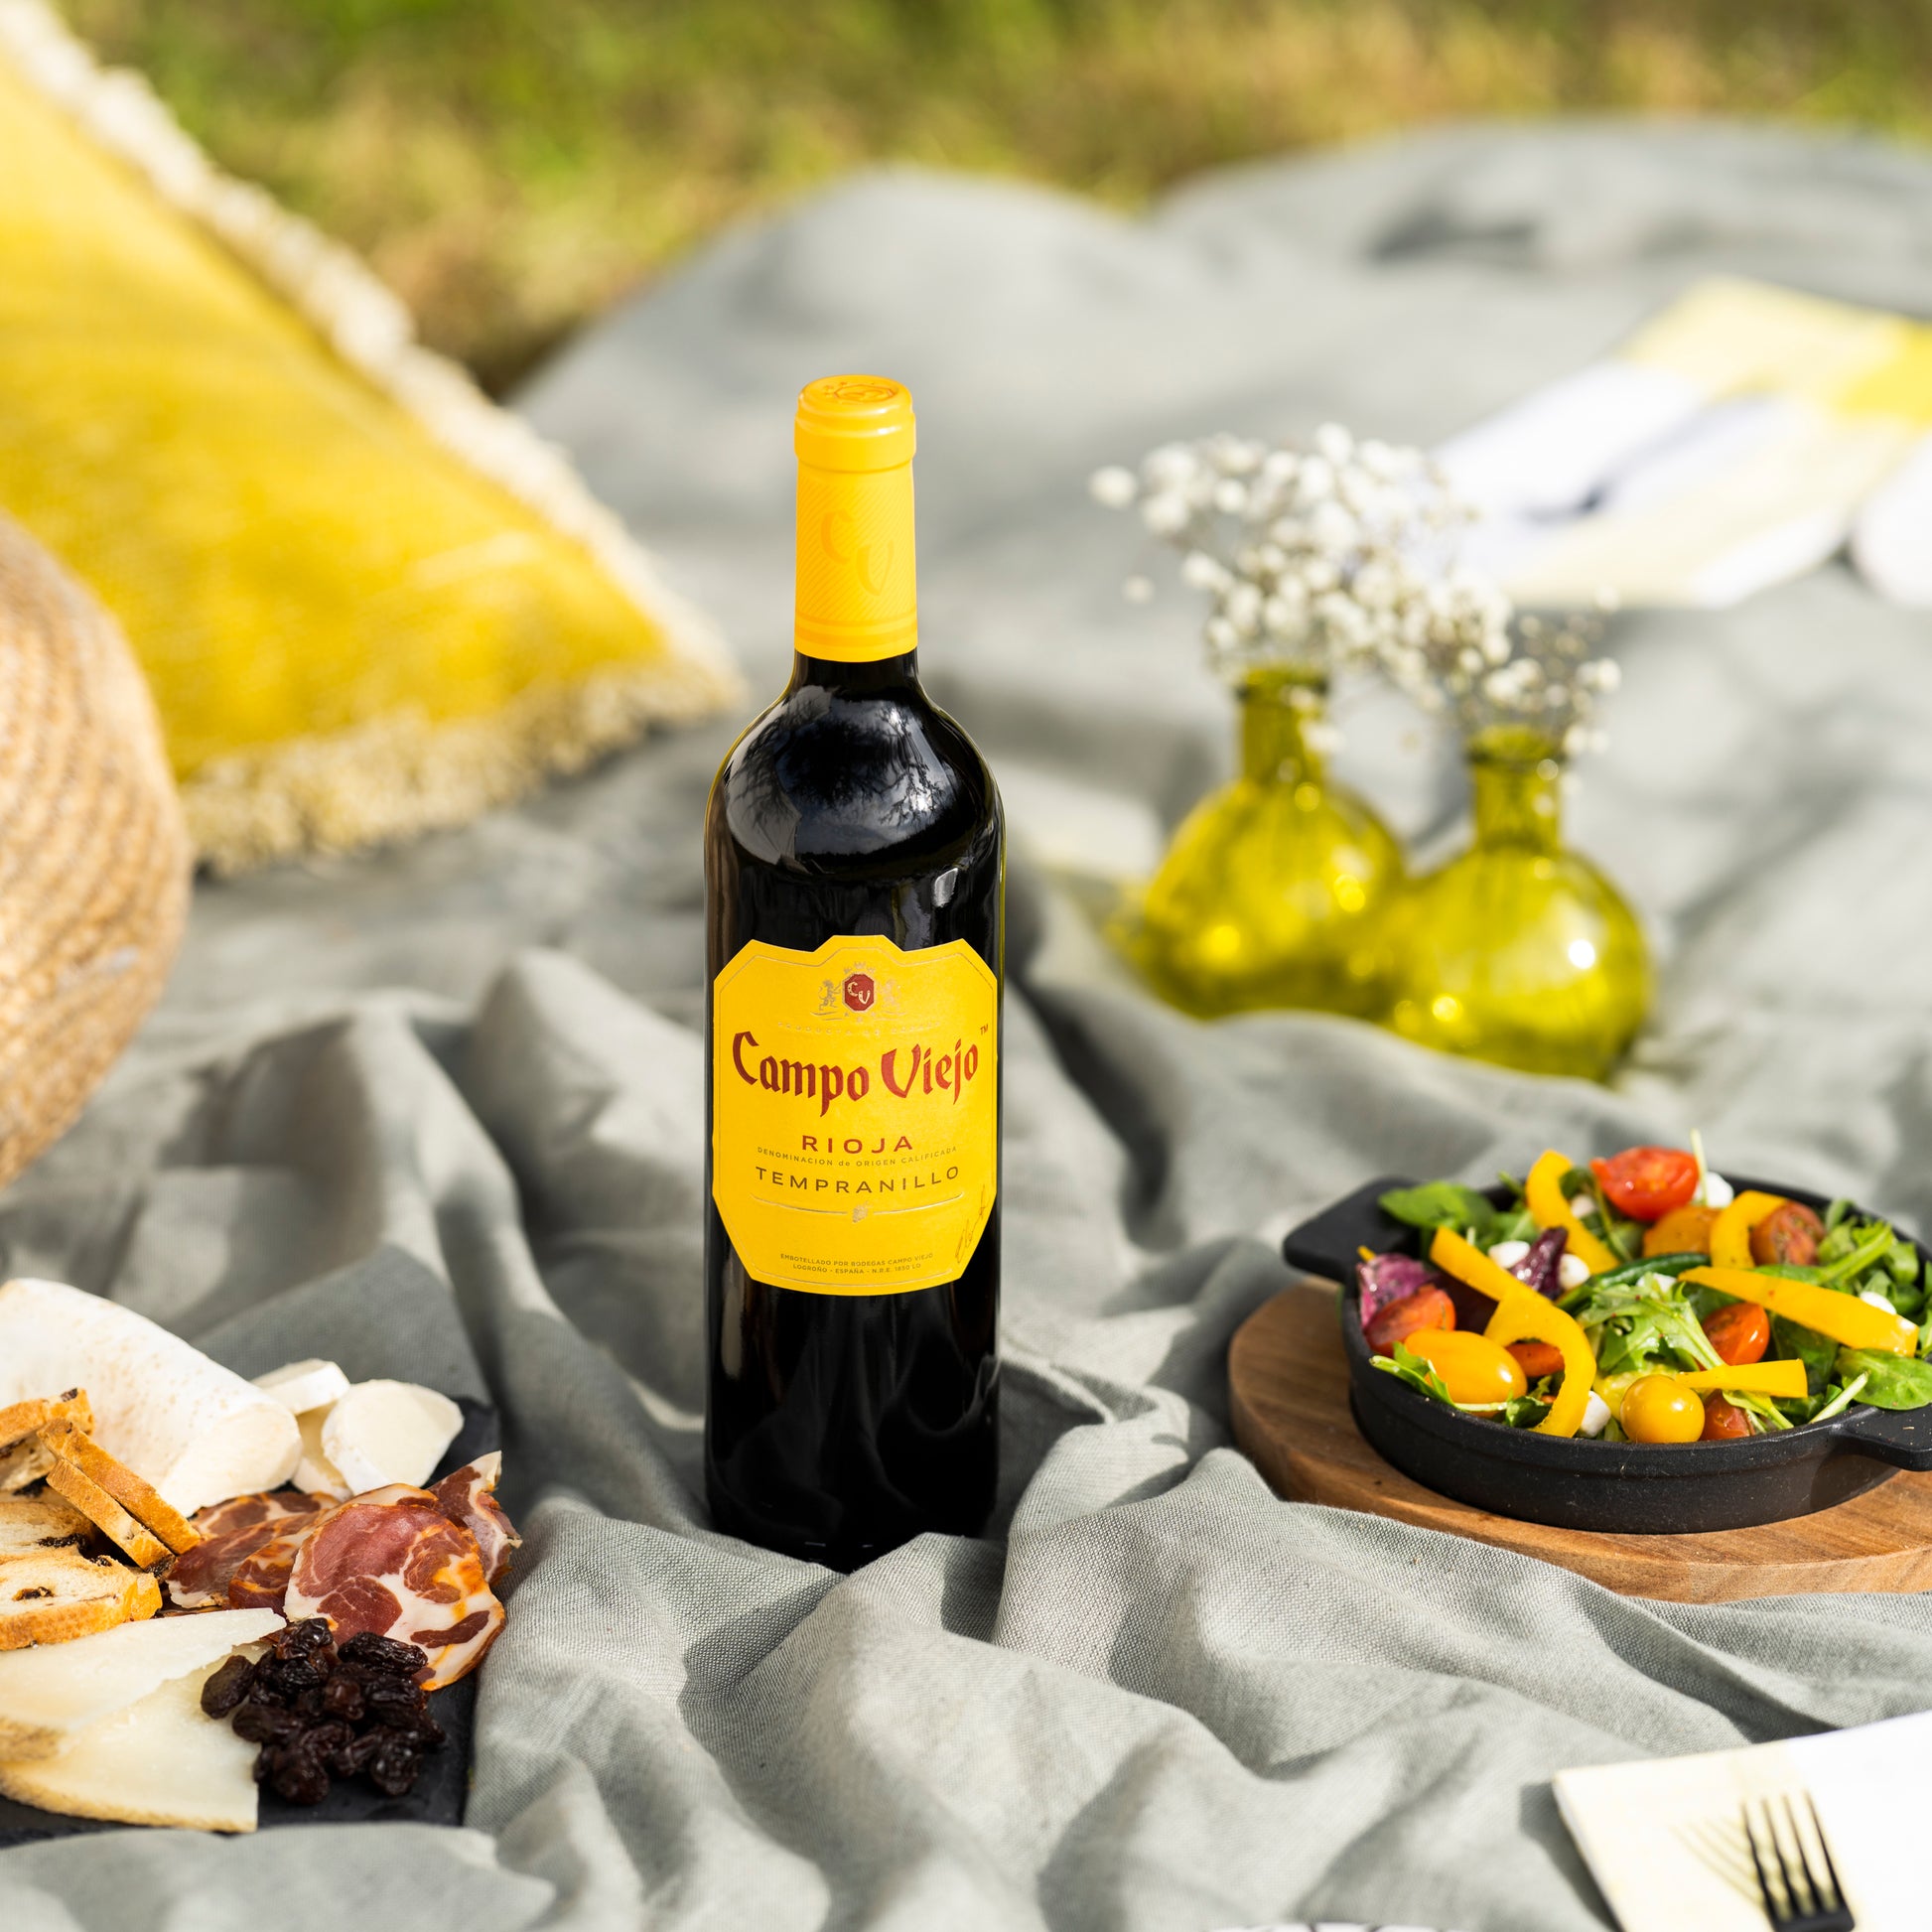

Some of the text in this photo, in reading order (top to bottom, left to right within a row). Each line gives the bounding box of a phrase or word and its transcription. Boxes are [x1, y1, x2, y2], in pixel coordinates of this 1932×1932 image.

[847, 981, 871, 1005] CV
[732, 1031, 870, 1118] Campo
[881, 1037, 979, 1106] Viejo
[801, 1135, 913, 1155] RIOJA
[758, 1146, 833, 1167] DENOMINACION
[900, 1146, 957, 1164] CALIFICADA
[756, 1166, 959, 1193] TEMPRANILLO
[780, 1253, 831, 1266] EMBOTELLADO
[888, 1256, 912, 1266] CAMPO
[914, 1252, 933, 1261] VIEJO
[792, 1263, 828, 1273] LOGROÑO
